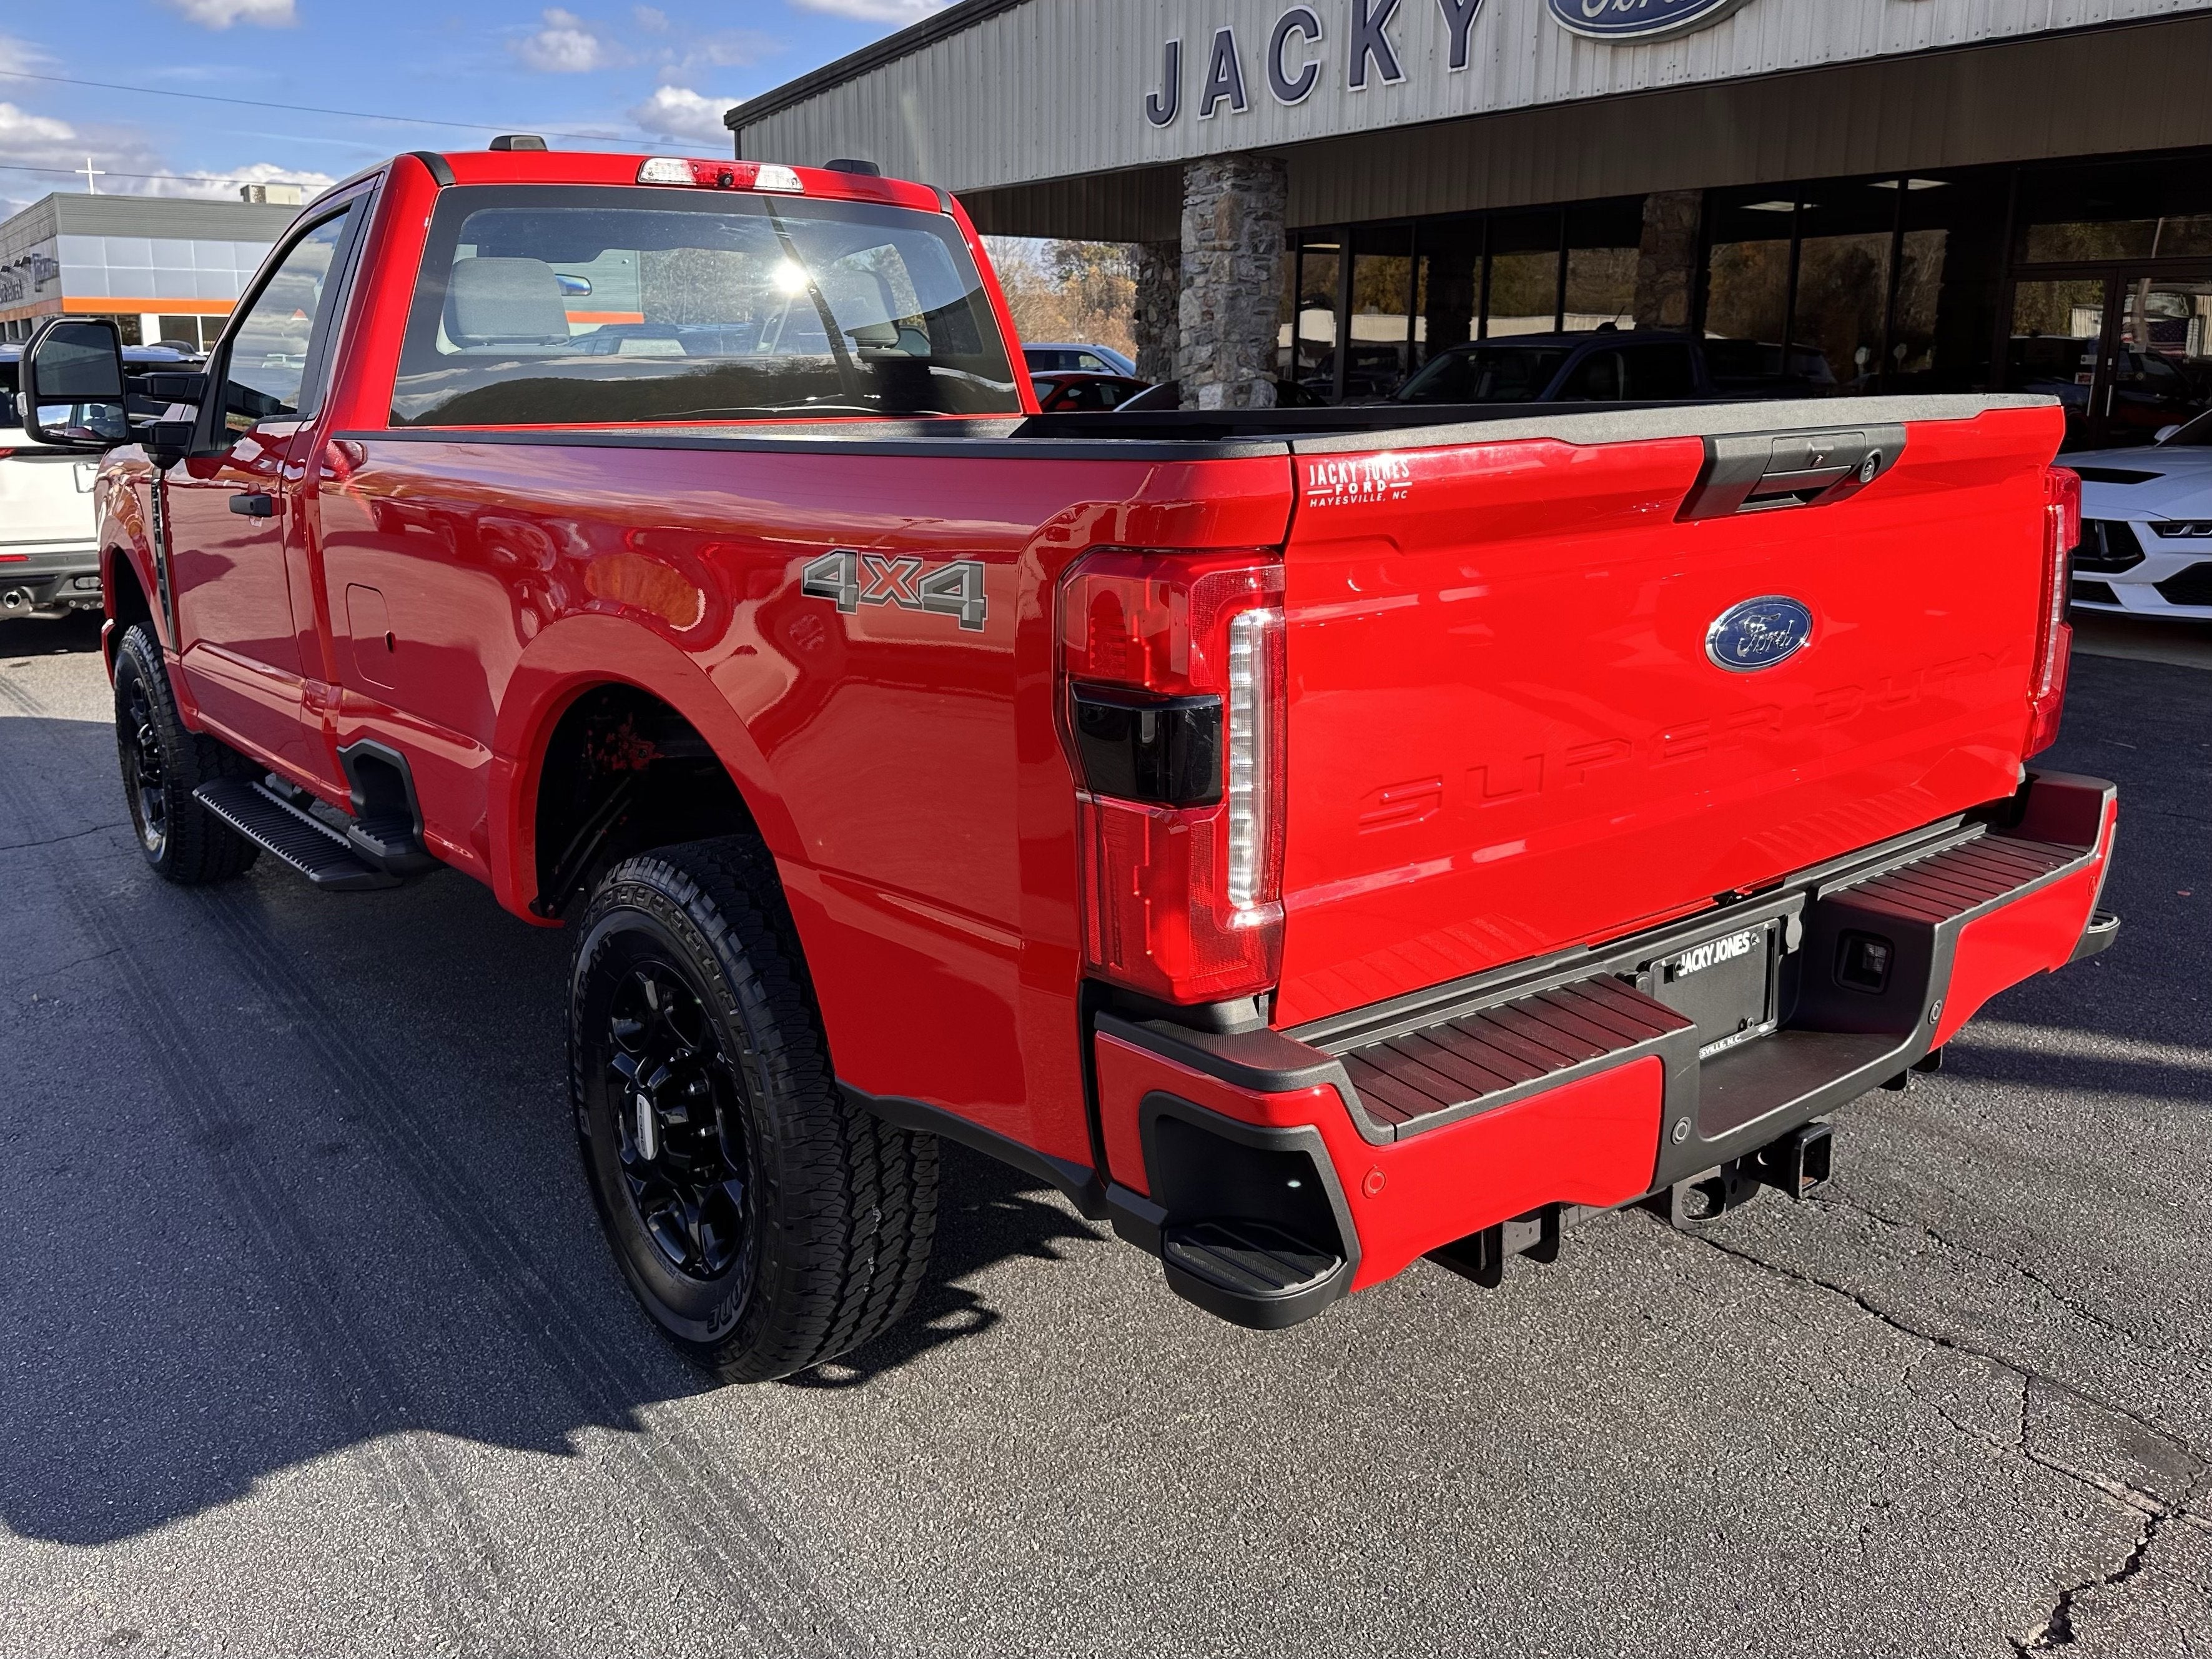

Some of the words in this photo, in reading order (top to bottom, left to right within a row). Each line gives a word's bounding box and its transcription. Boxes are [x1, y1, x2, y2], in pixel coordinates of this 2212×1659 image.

[1145, 0, 1483, 127] JACKY
[1310, 462, 1357, 487] JACKY
[1365, 458, 1410, 482] JONES
[1335, 479, 1386, 495] FORD
[1310, 493, 1386, 507] HAYESVILLE,
[1392, 490, 1408, 500] NC
[1737, 612, 1795, 657] Ford
[1358, 703, 1784, 835] SUPER
[1813, 645, 2012, 726] DUTY
[1679, 943, 1714, 977] JACKY
[1713, 931, 1750, 963] JONES
